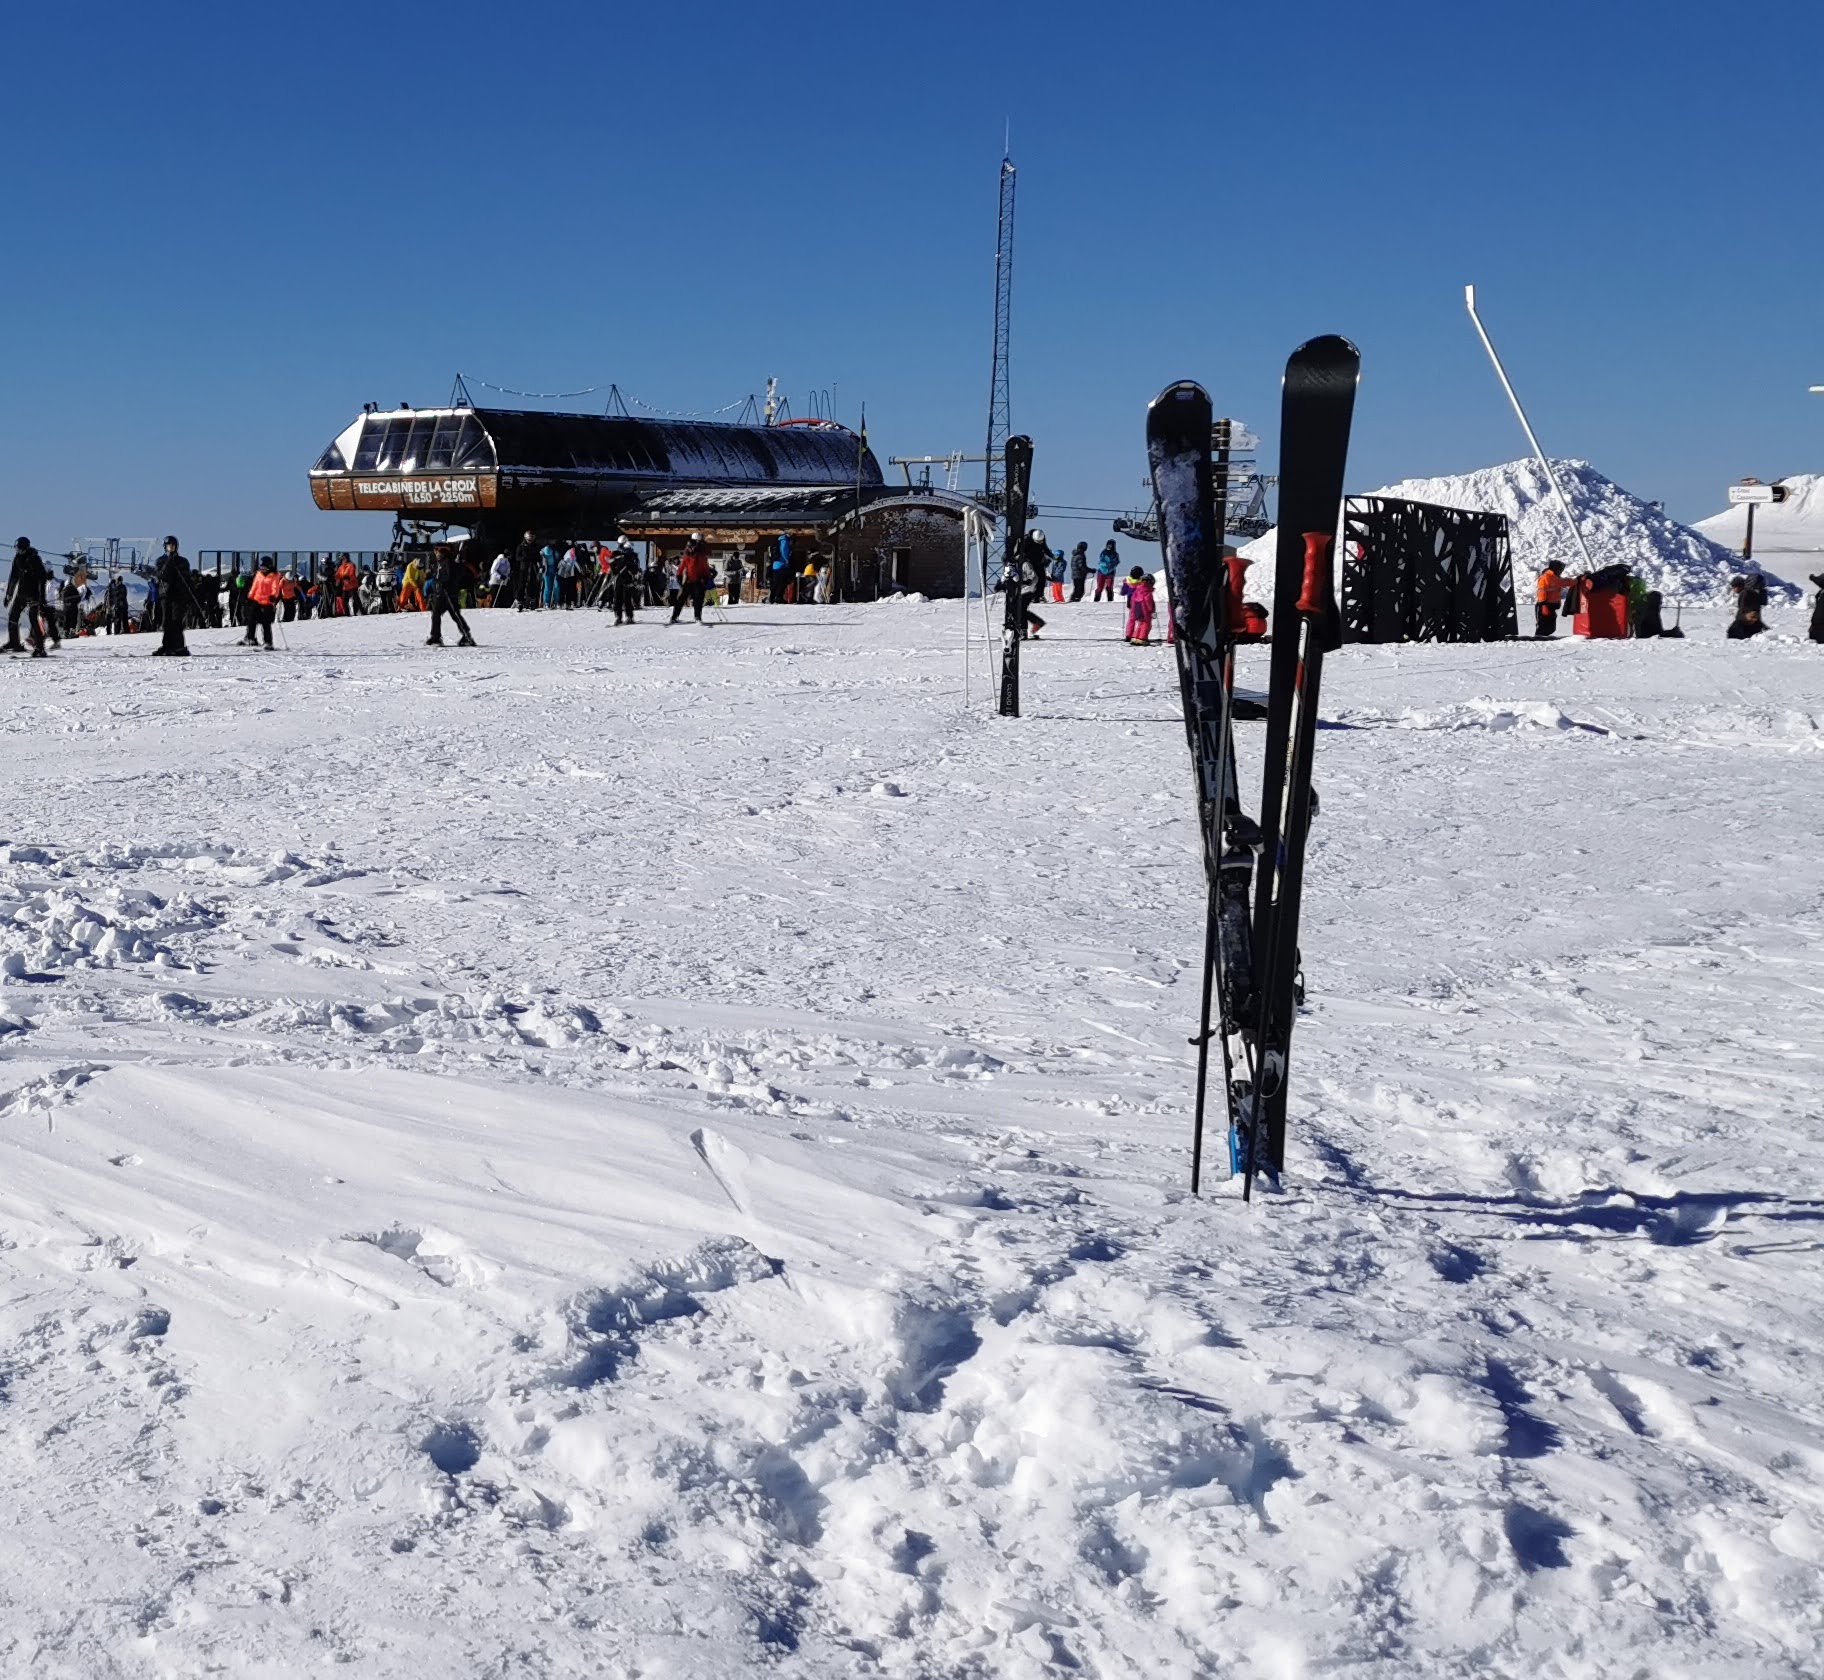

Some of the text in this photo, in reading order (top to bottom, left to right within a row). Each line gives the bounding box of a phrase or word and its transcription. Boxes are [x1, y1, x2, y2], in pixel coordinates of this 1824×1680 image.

[358, 480, 477, 493] TELECABINE DE LA CROIX
[409, 492, 432, 503] 1650
[440, 491, 475, 503] 2250m
